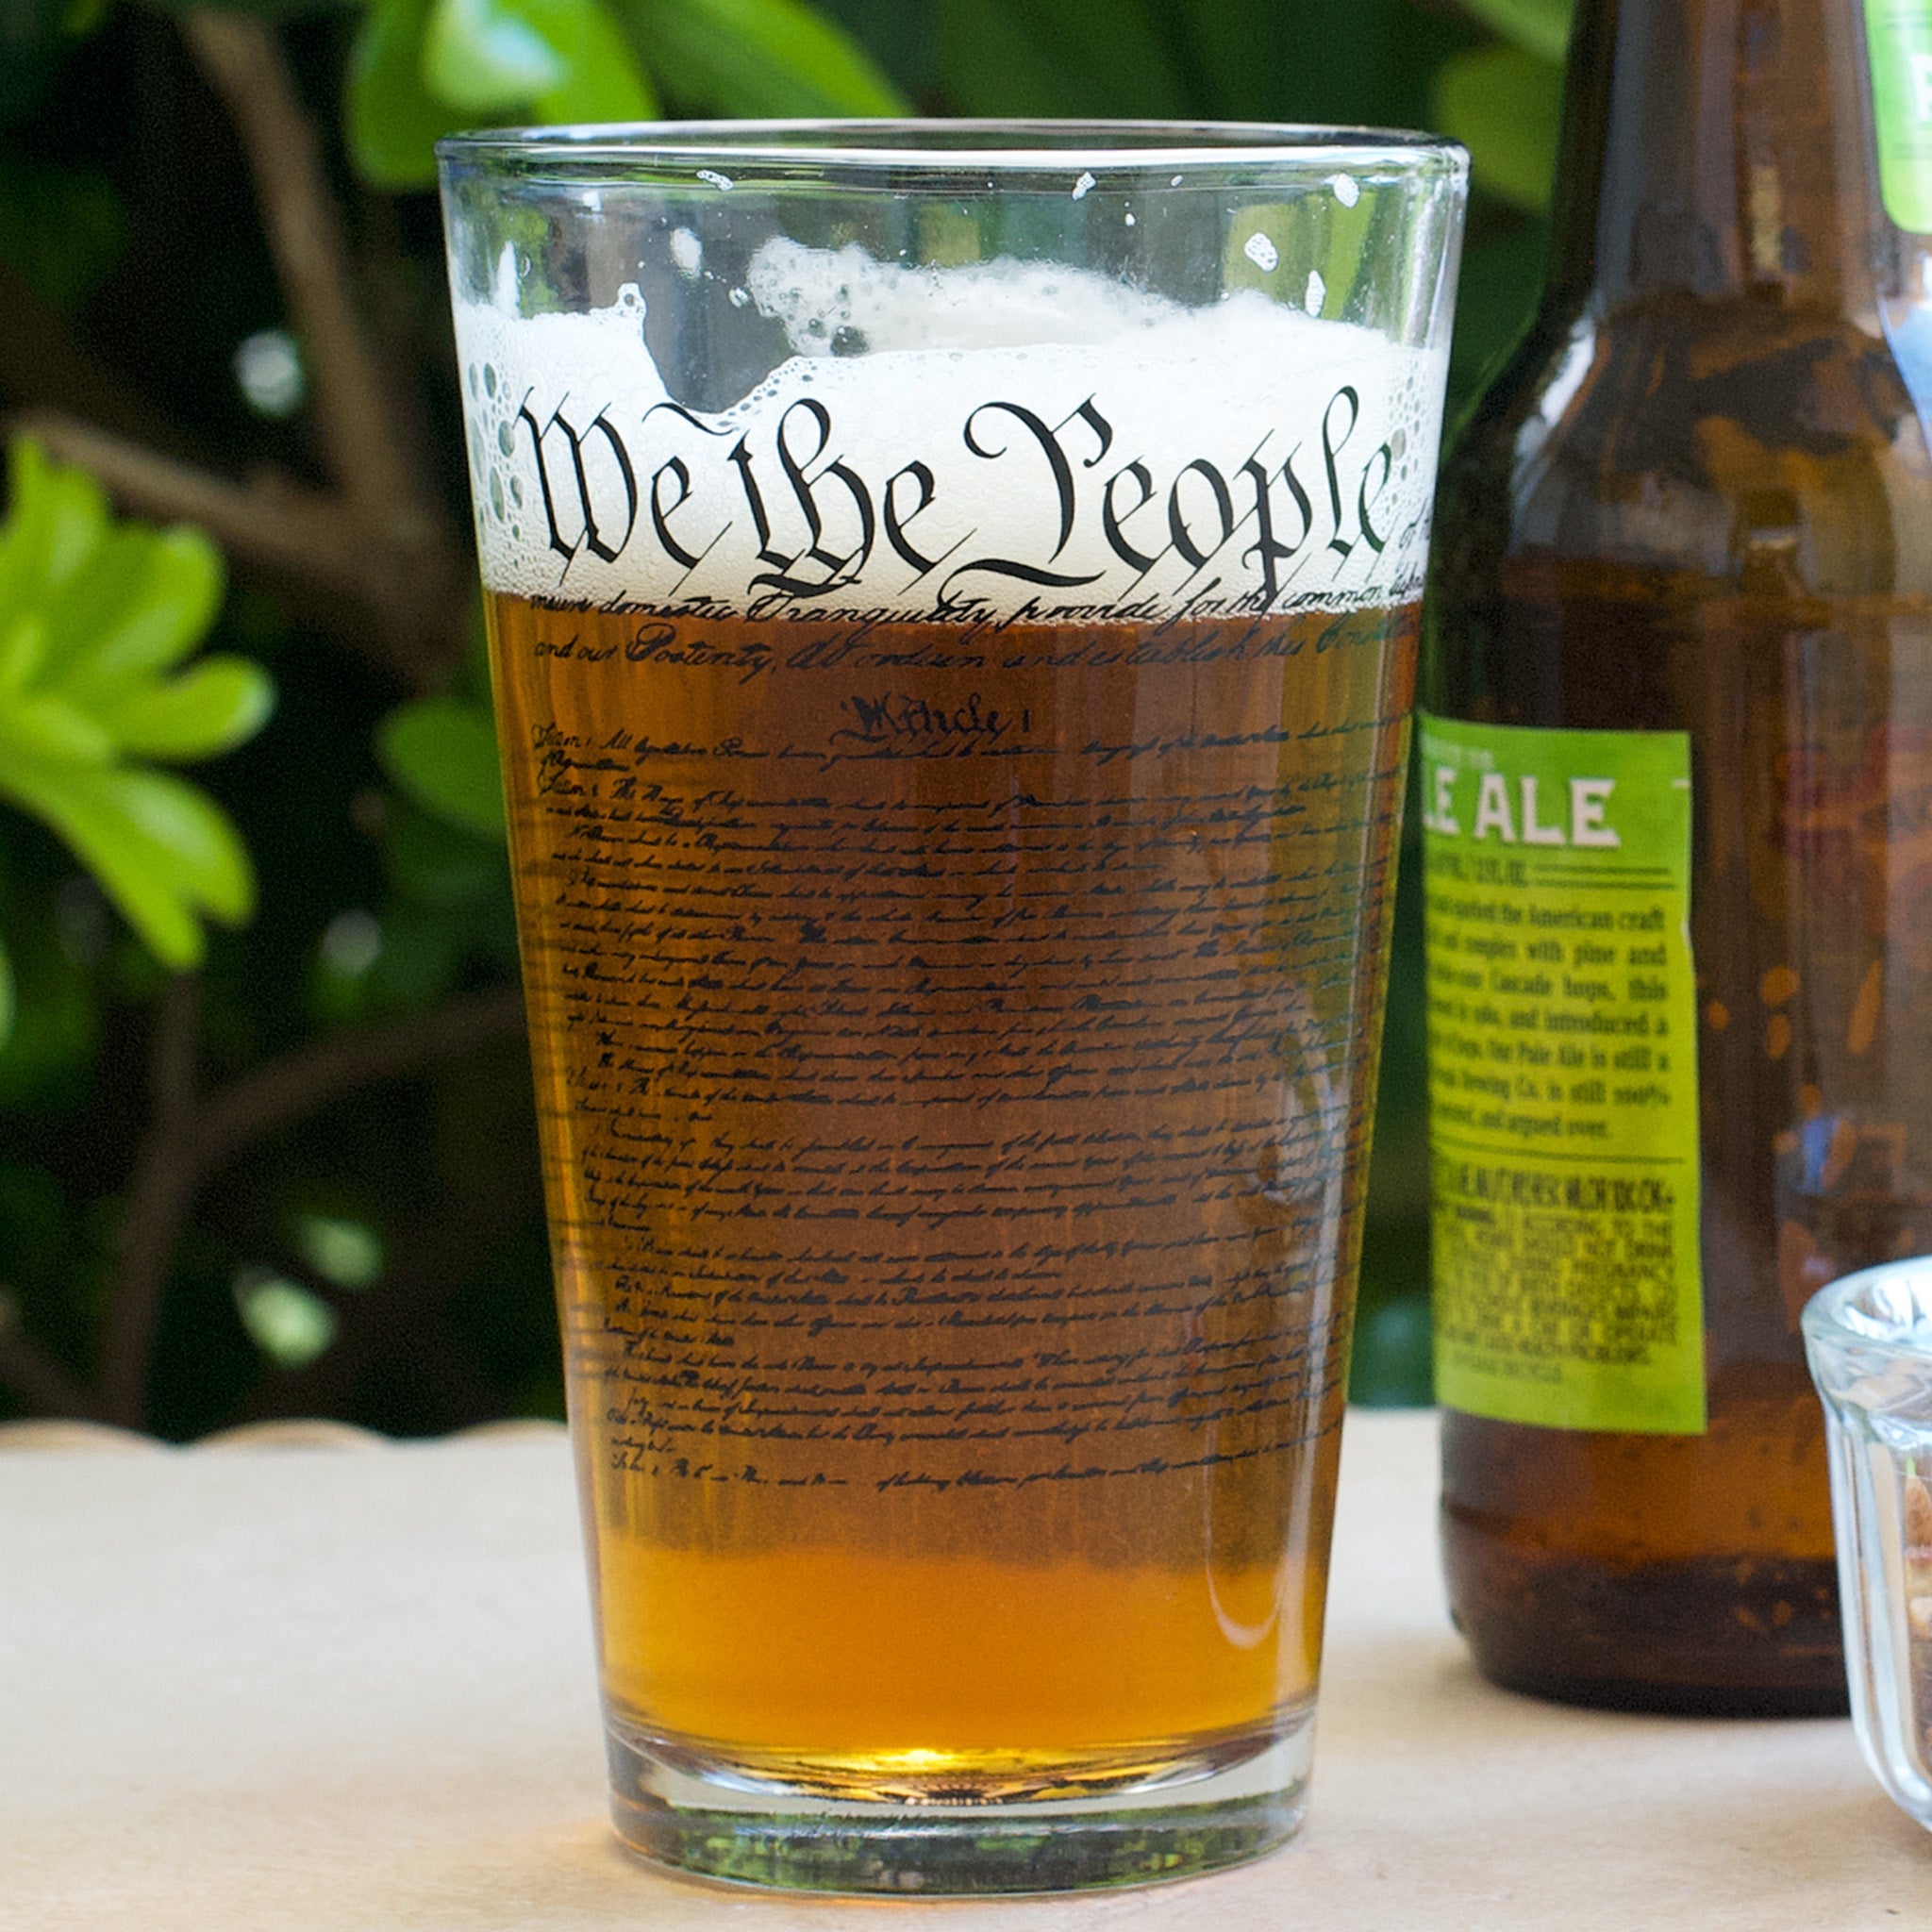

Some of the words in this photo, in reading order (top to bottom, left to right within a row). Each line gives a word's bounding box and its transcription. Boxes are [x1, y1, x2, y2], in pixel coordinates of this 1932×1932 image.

[512, 386, 733, 597] We
[642, 397, 977, 598] the
[937, 385, 1399, 623] People
[597, 590, 741, 622] domestic
[993, 593, 1171, 634] provide
[534, 634, 577, 658] and
[1474, 771, 1622, 847] ALE
